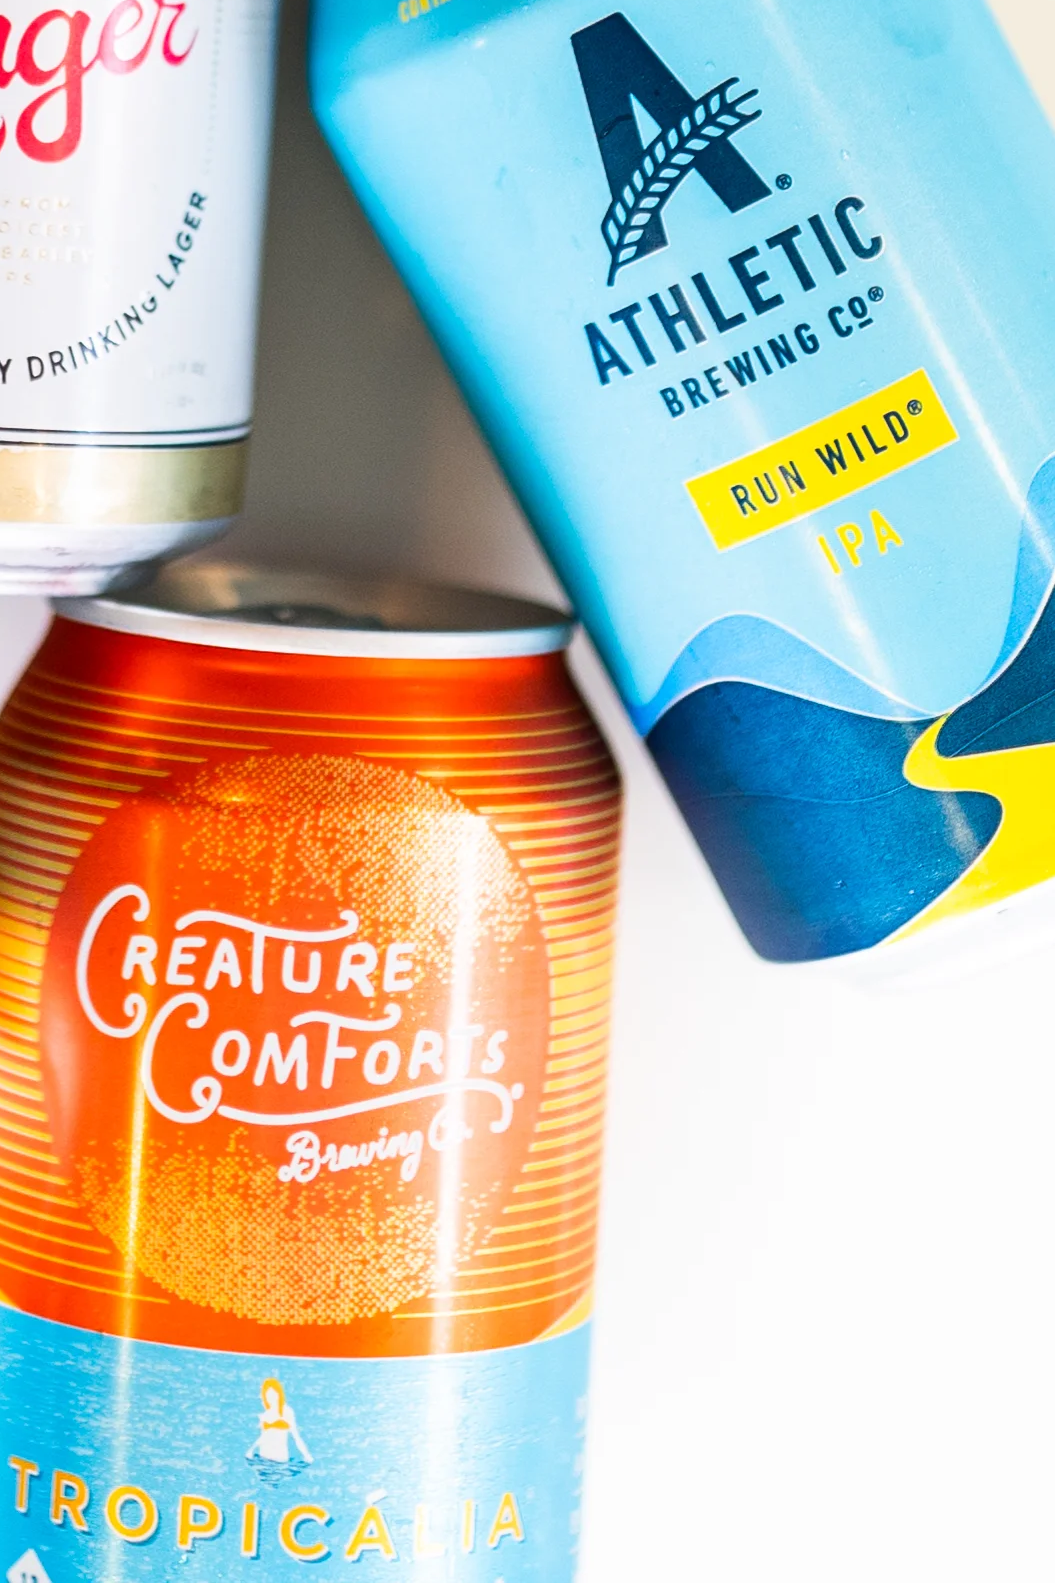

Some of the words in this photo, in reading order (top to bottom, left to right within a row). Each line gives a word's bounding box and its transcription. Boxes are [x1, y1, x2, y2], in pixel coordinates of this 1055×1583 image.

[27, 290, 159, 381] DRINKING
[156, 190, 209, 291] LAGER
[583, 194, 885, 389] ATHLETIC
[659, 320, 823, 420] BREWING
[729, 458, 807, 516] RUN
[817, 508, 905, 575] IPA
[77, 884, 418, 1038] CREATURE
[145, 992, 524, 1132] COMFORTS
[277, 1126, 423, 1184] Brewing
